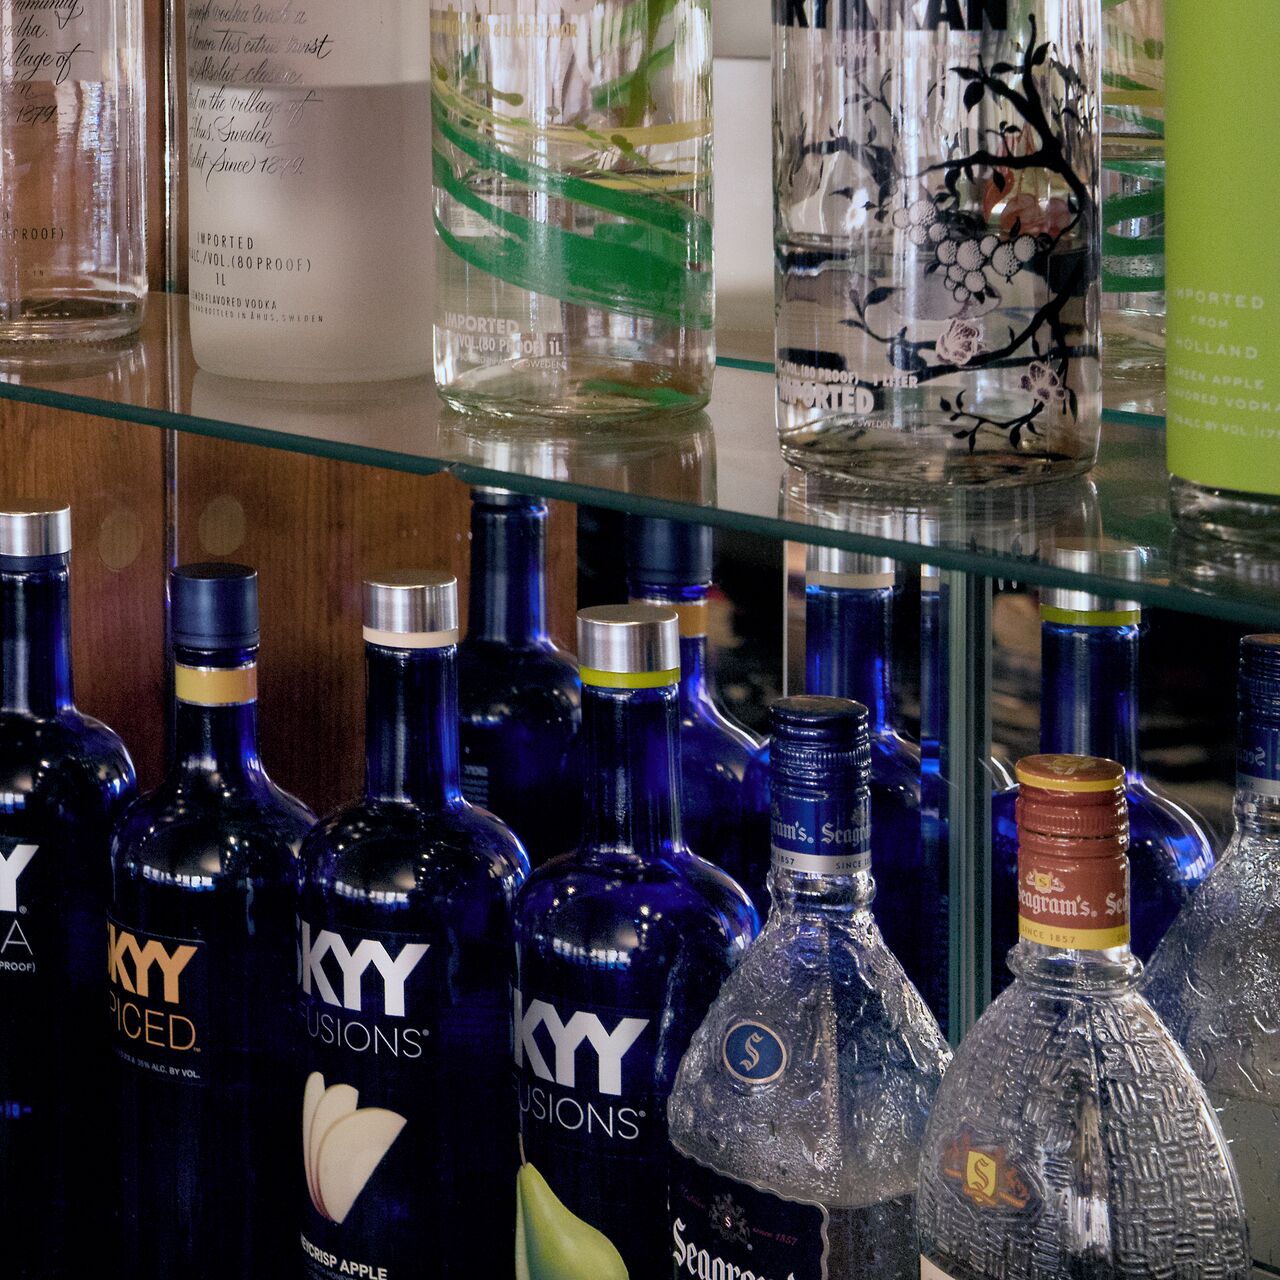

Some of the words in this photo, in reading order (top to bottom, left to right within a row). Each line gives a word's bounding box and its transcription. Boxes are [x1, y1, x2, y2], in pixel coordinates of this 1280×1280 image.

[55, 43, 95, 86] of
[208, 86, 226, 112] the
[197, 231, 254, 250] IMPORTED
[215, 272, 226, 286] 1L
[205, 293, 242, 308] FLAVORED
[245, 298, 277, 310] VODKA
[445, 311, 519, 335] IMPORTED
[1191, 315, 1230, 330] FROM
[548, 340, 562, 356] 1L
[1175, 336, 1259, 361] HOLLAND
[882, 374, 918, 389] LITER
[1212, 374, 1265, 392] APPLE
[778, 855, 795, 867] 1857
[835, 858, 862, 871] SINCE
[1022, 924, 1046, 940] SINCE
[1049, 933, 1076, 944] 1857
[151, 1063, 168, 1074] ALC.
[169, 1067, 180, 1076] BY
[181, 1069, 201, 1079] VOL.
[774, 1233, 799, 1246] 1857
[339, 1258, 389, 1280] APPLE
